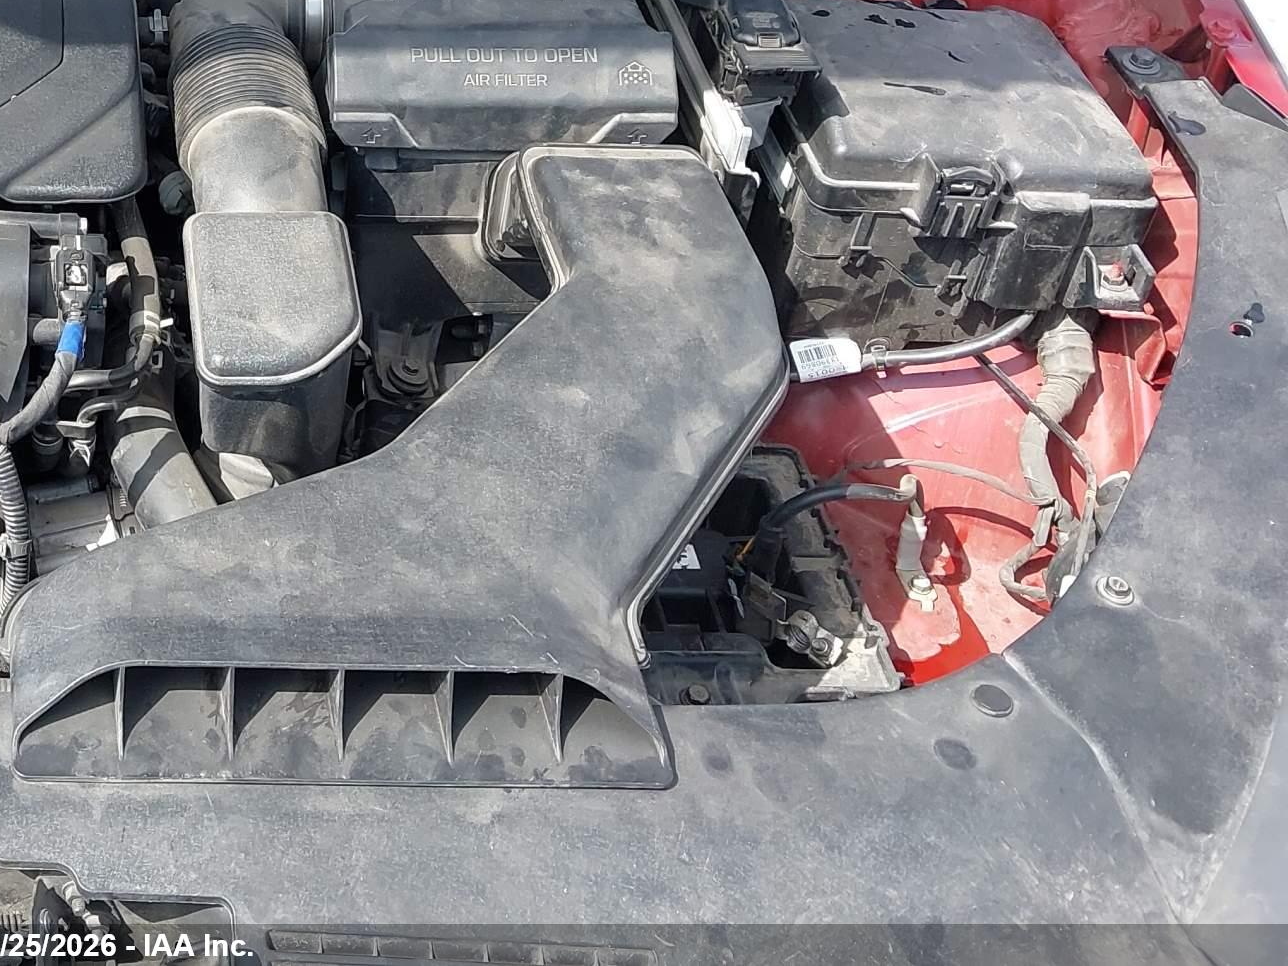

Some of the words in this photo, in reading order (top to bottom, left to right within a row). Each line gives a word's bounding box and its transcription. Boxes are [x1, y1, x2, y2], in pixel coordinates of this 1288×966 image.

[410, 47, 462, 63] PULL
[466, 47, 507, 63] OUT
[511, 47, 539, 63] TO
[543, 47, 599, 63] OPEN
[463, 73, 491, 87] AIR
[494, 73, 548, 87] FILTER
